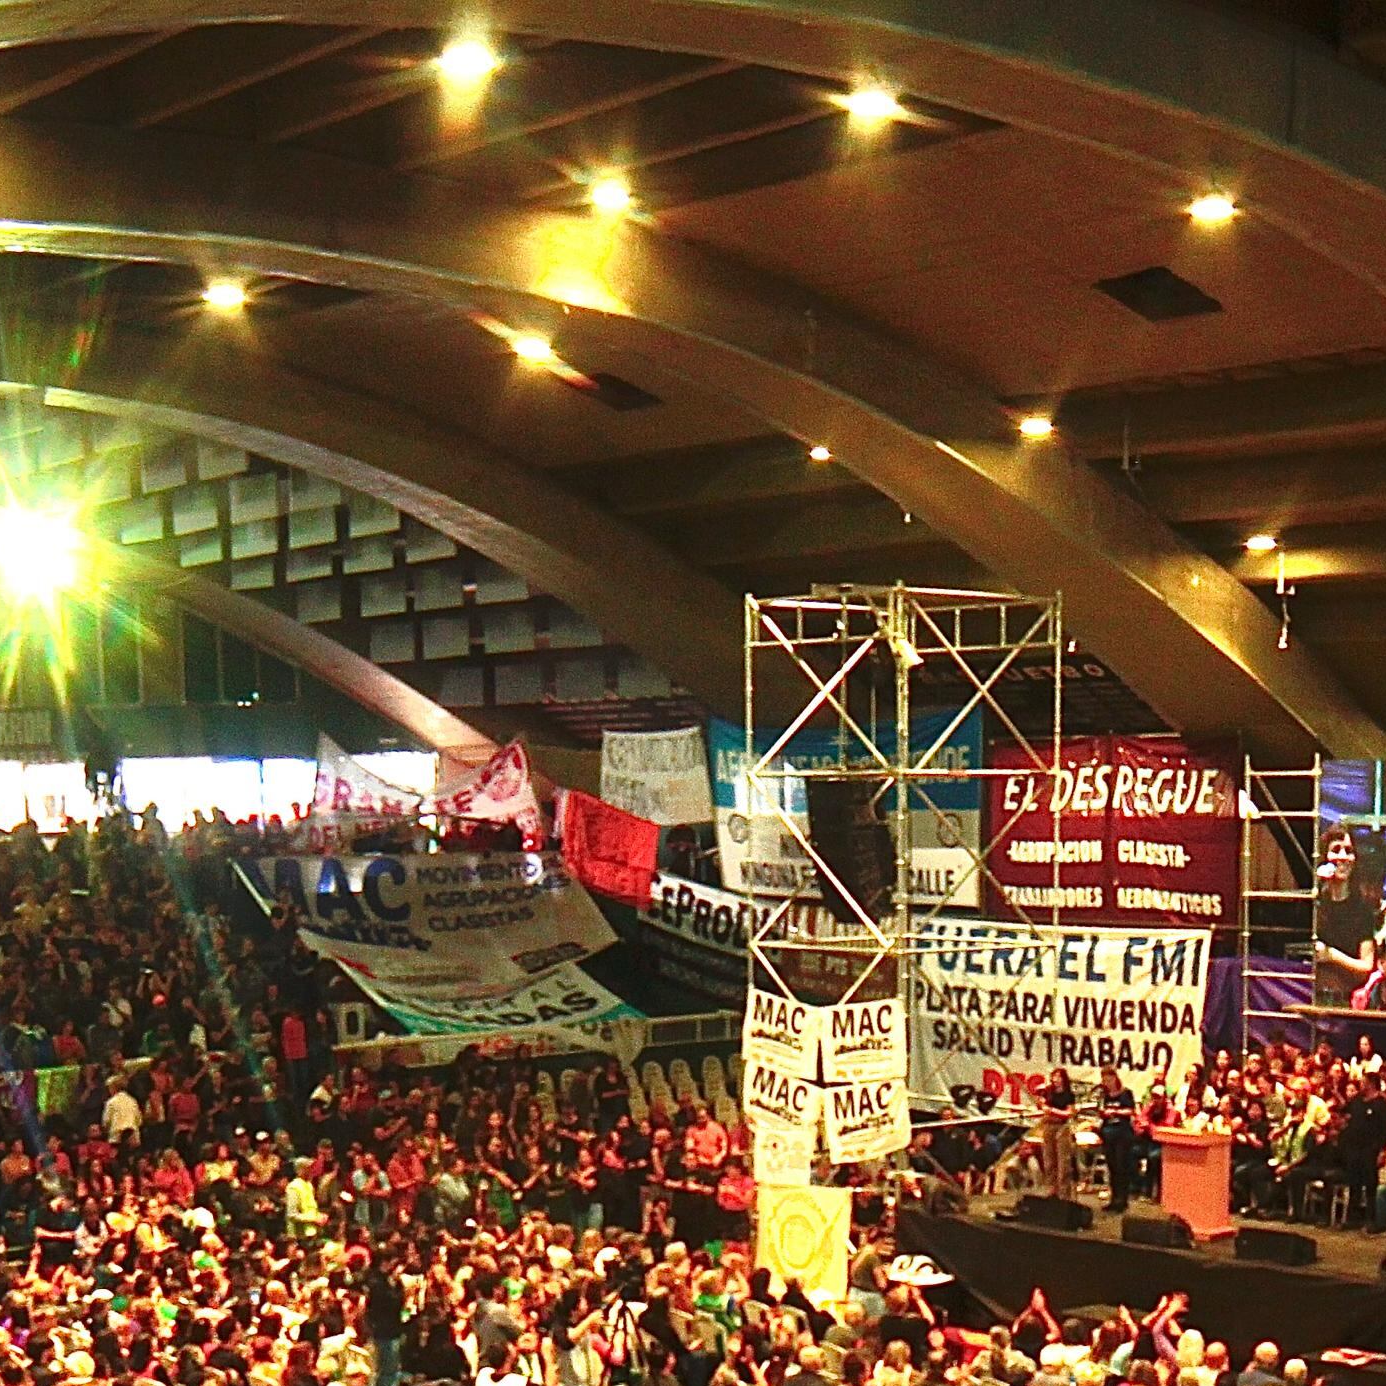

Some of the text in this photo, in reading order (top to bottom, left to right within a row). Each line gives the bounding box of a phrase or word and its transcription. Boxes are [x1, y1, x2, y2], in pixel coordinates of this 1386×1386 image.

[1003, 776, 1039, 811] EL
[914, 923, 1044, 978] FUERA
[1057, 934, 1107, 983] EL
[1123, 936, 1204, 988] FMI
[752, 993, 806, 1035] MAC
[831, 1004, 893, 1040] MAC
[914, 979, 1197, 1035] PLATA PARA VIVIENDA
[932, 1018, 1174, 1073] SALUD Y TRABAJO
[752, 1065, 808, 1112] MAC
[833, 1082, 893, 1122] MAC
